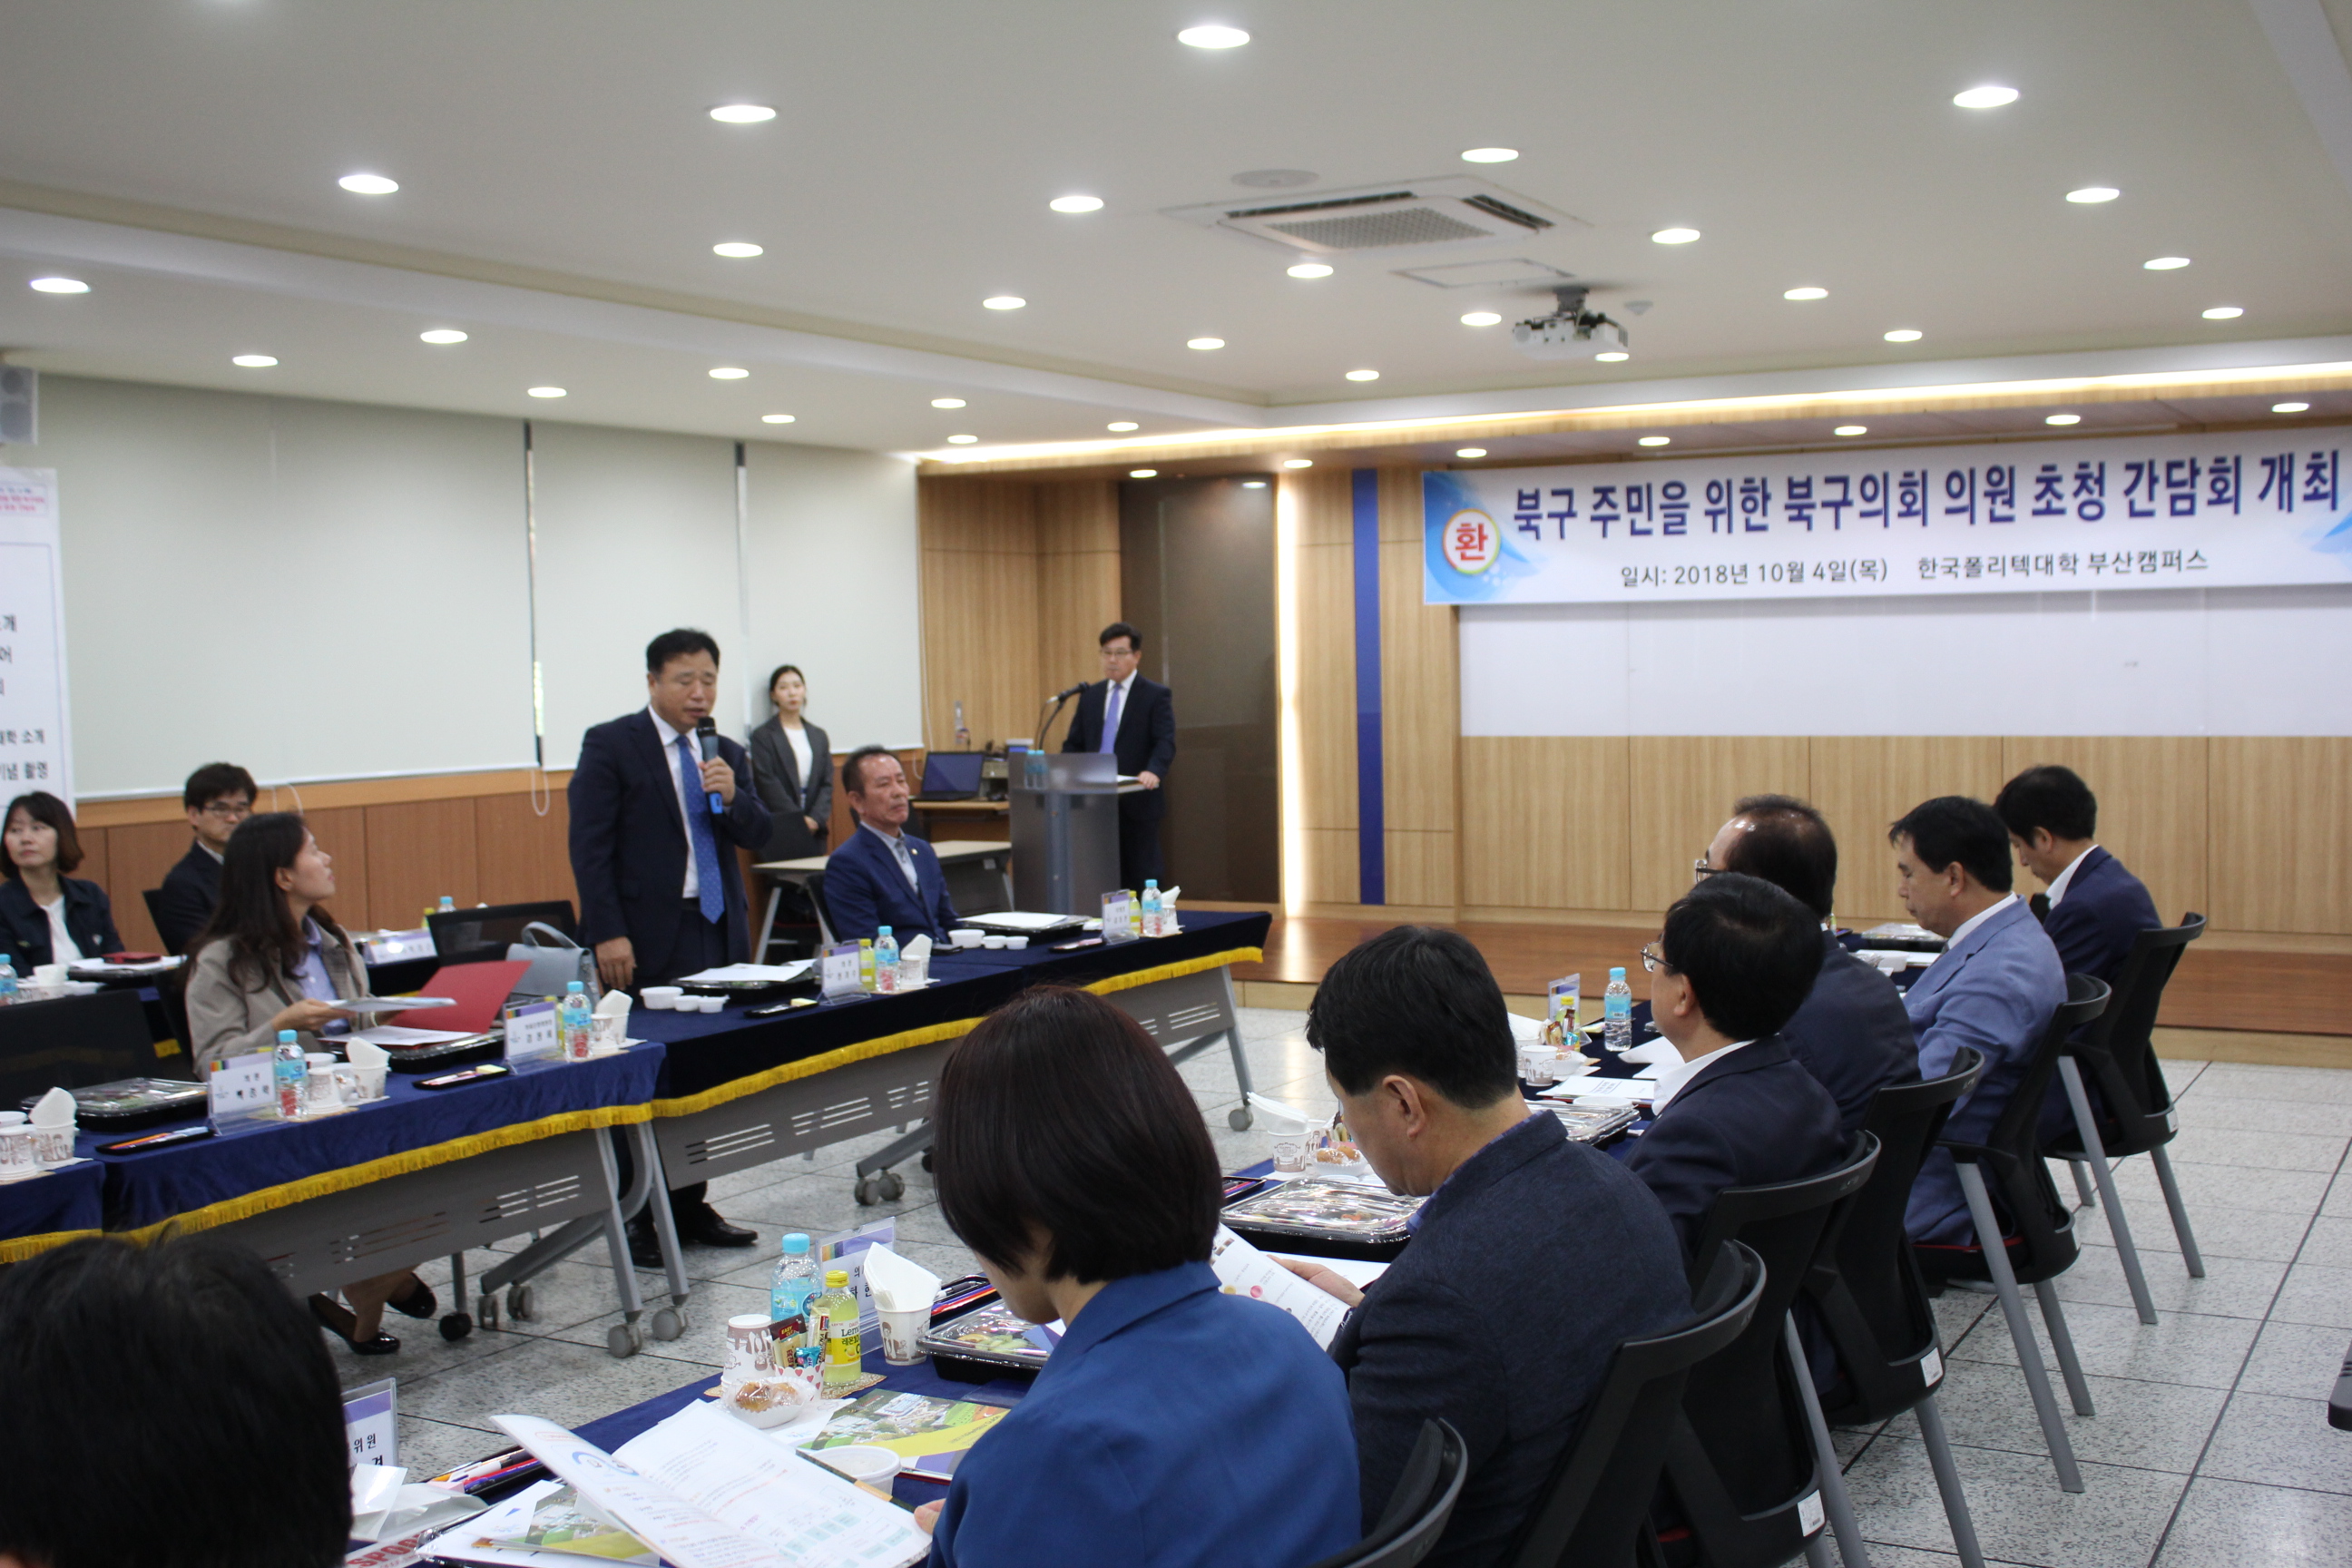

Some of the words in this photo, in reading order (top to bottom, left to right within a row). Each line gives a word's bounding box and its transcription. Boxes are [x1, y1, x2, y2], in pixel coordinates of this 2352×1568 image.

[1514, 486, 1579, 541] 북구
[1590, 479, 1691, 539] 주민을
[1704, 475, 1772, 535] 위한
[1784, 468, 1930, 532] 북구의회
[1944, 464, 2017, 526] 의원
[2031, 460, 2107, 523] 초청
[2122, 454, 2243, 518] 간담회
[2258, 448, 2341, 514] 개최
[1454, 523, 1490, 561] 환
[1622, 564, 1668, 588] 일시:
[1674, 562, 1749, 585] 2018년
[1759, 560, 1807, 584] 10월
[1812, 556, 1888, 583] 4일(목)
[1917, 552, 2081, 581] 한국폴리텍대학
[2087, 547, 2210, 576] 부산캠퍼스
[840, 1327, 860, 1338] Lem
[347, 1529, 429, 1568] SPOO
